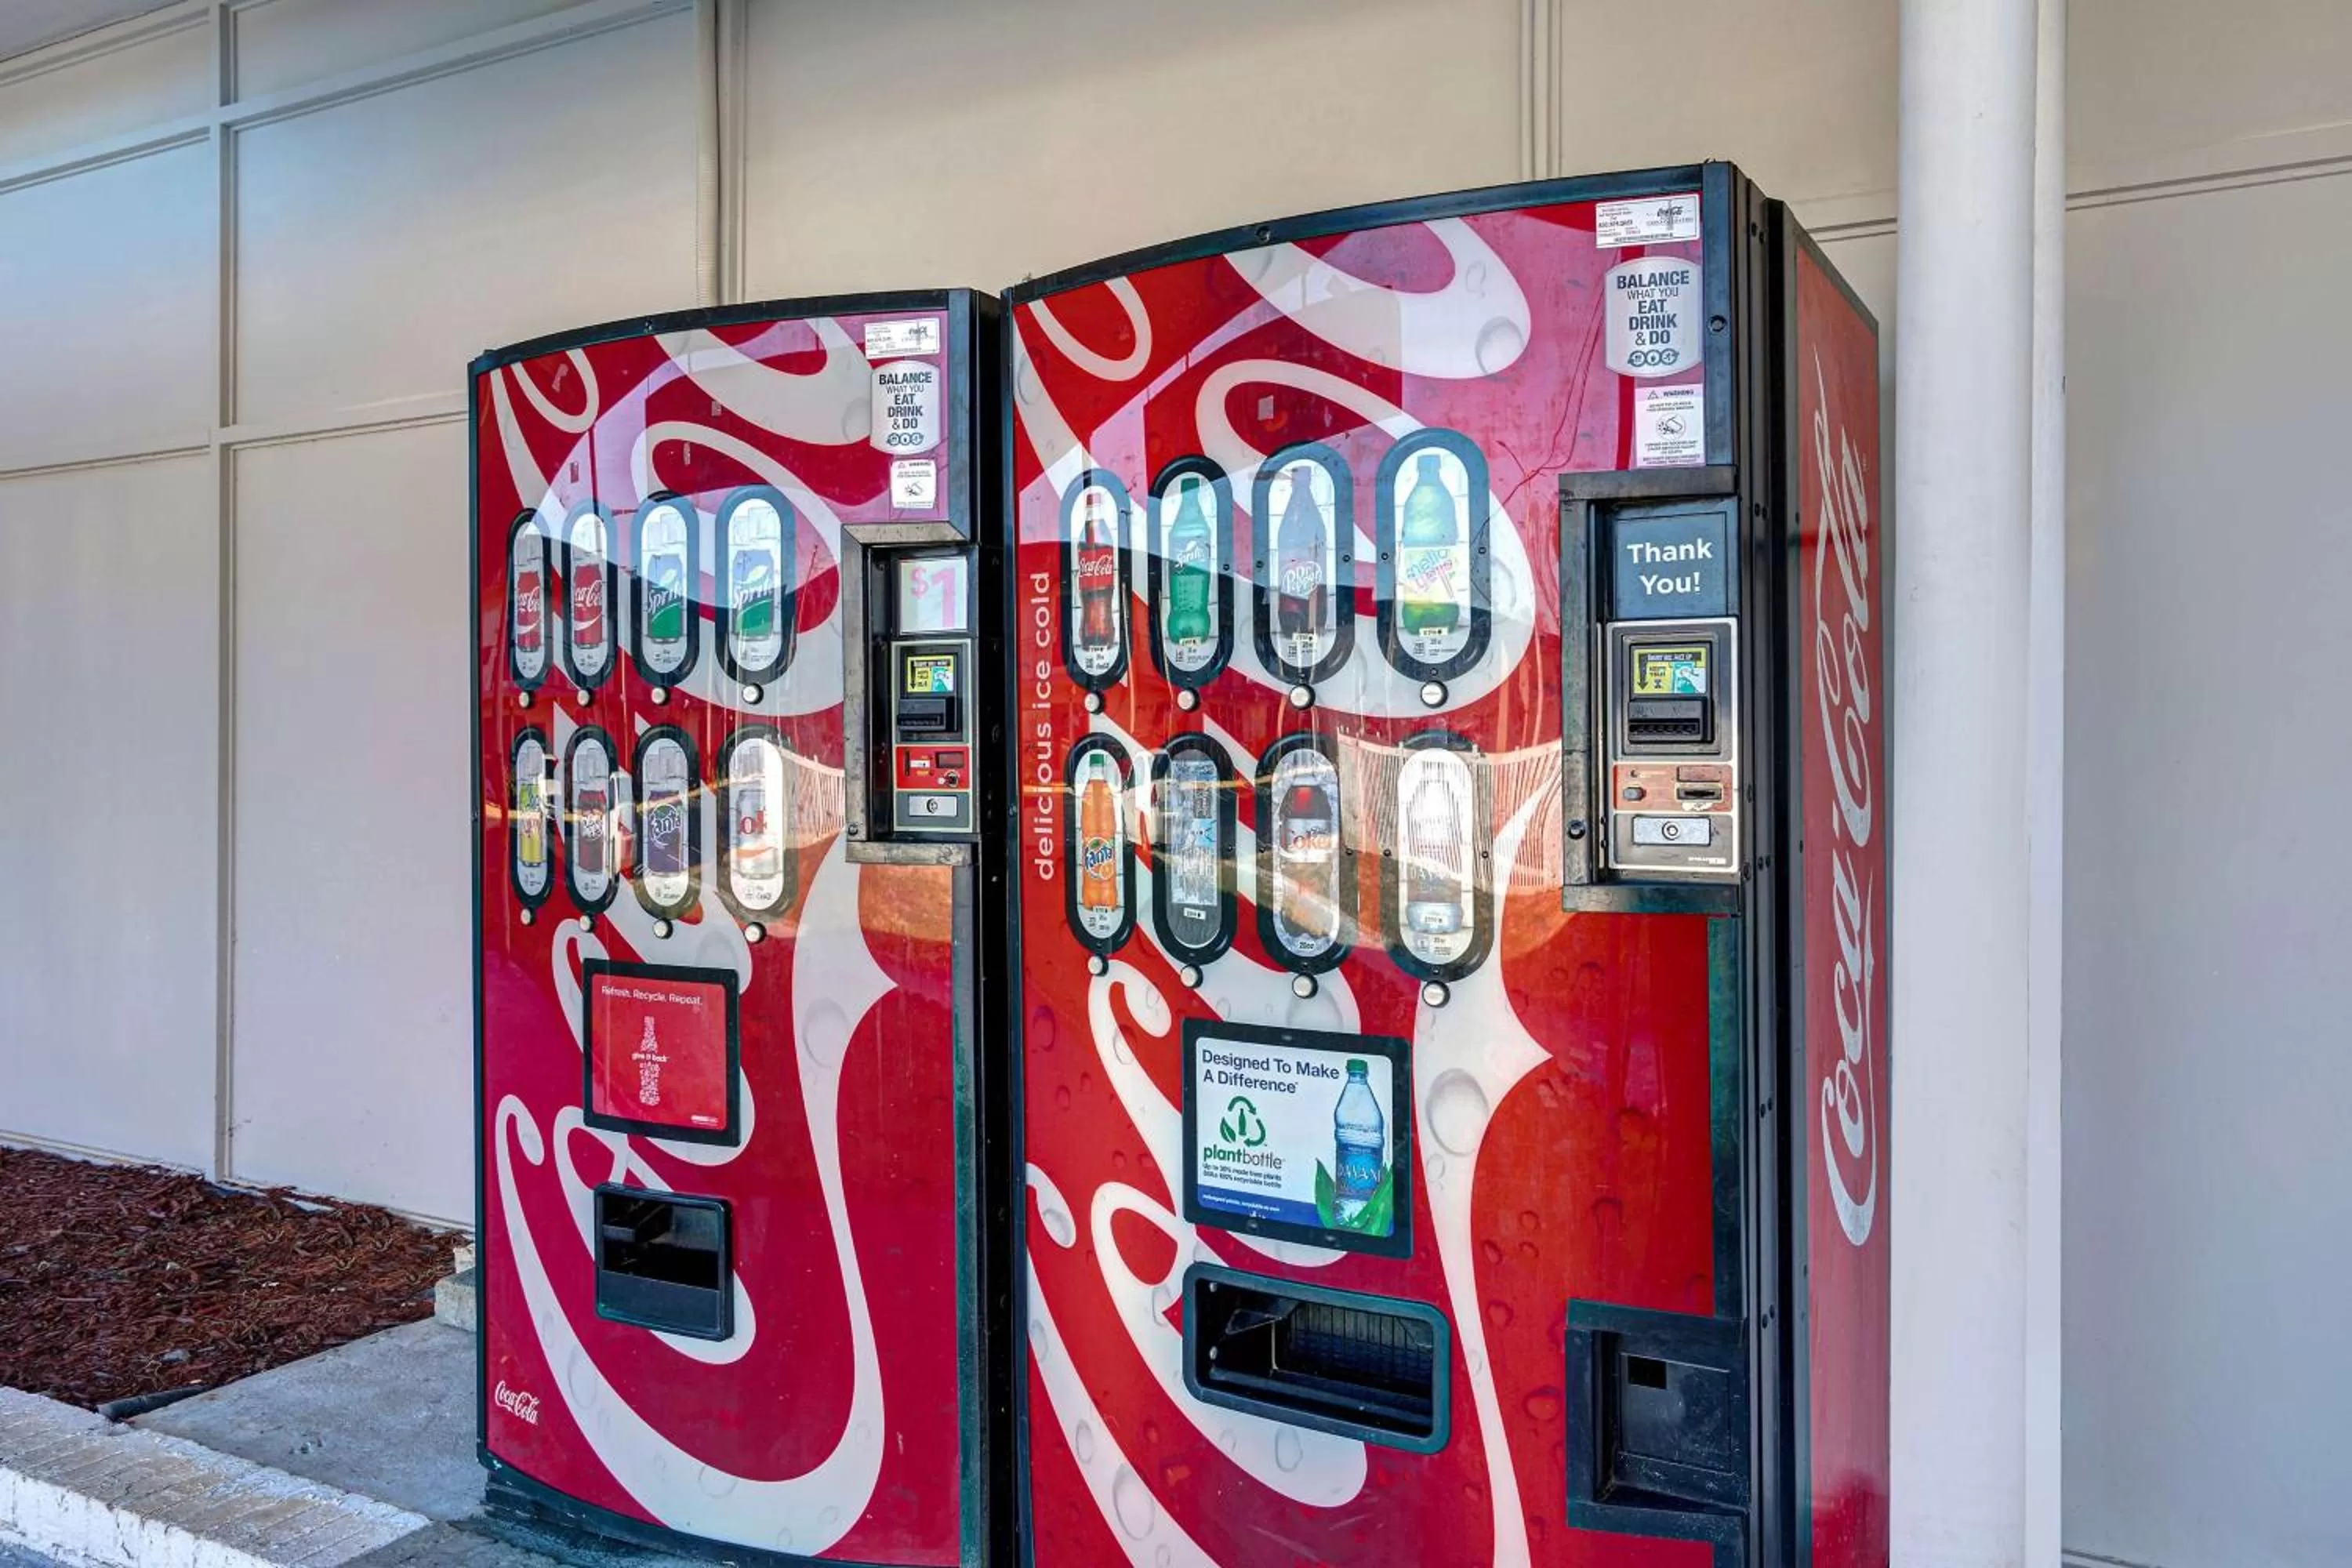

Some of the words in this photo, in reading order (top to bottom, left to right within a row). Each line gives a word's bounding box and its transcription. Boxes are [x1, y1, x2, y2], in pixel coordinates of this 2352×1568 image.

[1617, 270, 1690, 289] BALANCE
[1627, 289, 1656, 300] WHAT
[1658, 287, 1679, 298] YOU
[1628, 314, 1677, 330] DRINK
[1635, 332, 1646, 346] &
[1649, 329, 1671, 344] DO
[879, 372, 932, 385] BALANCE
[886, 385, 907, 394] WHAT
[909, 384, 924, 393] YOU
[887, 405, 923, 417] DRINK
[891, 419, 900, 430] &
[902, 418, 918, 429] DO
[1627, 538, 1713, 564] Thank
[1639, 572, 1700, 595] You!
[910, 565, 956, 627] $1
[1029, 572, 1051, 648] cold
[1032, 659, 1051, 709] ice
[1033, 721, 1054, 880] delicious
[1813, 344, 1877, 1246] Coca-Cola
[1084, 847, 1113, 871] Fanta
[633, 989, 666, 1003] Recycle.
[669, 993, 702, 1005] Repeat.
[1202, 1049, 1269, 1071] Designed
[1273, 1058, 1291, 1073] To
[1296, 1061, 1340, 1080] Make
[1203, 1069, 1214, 1083] A
[1218, 1071, 1297, 1094] Difference
[1203, 1144, 1282, 1169] plantbottle
[495, 1380, 540, 1425] Coca-Cola
